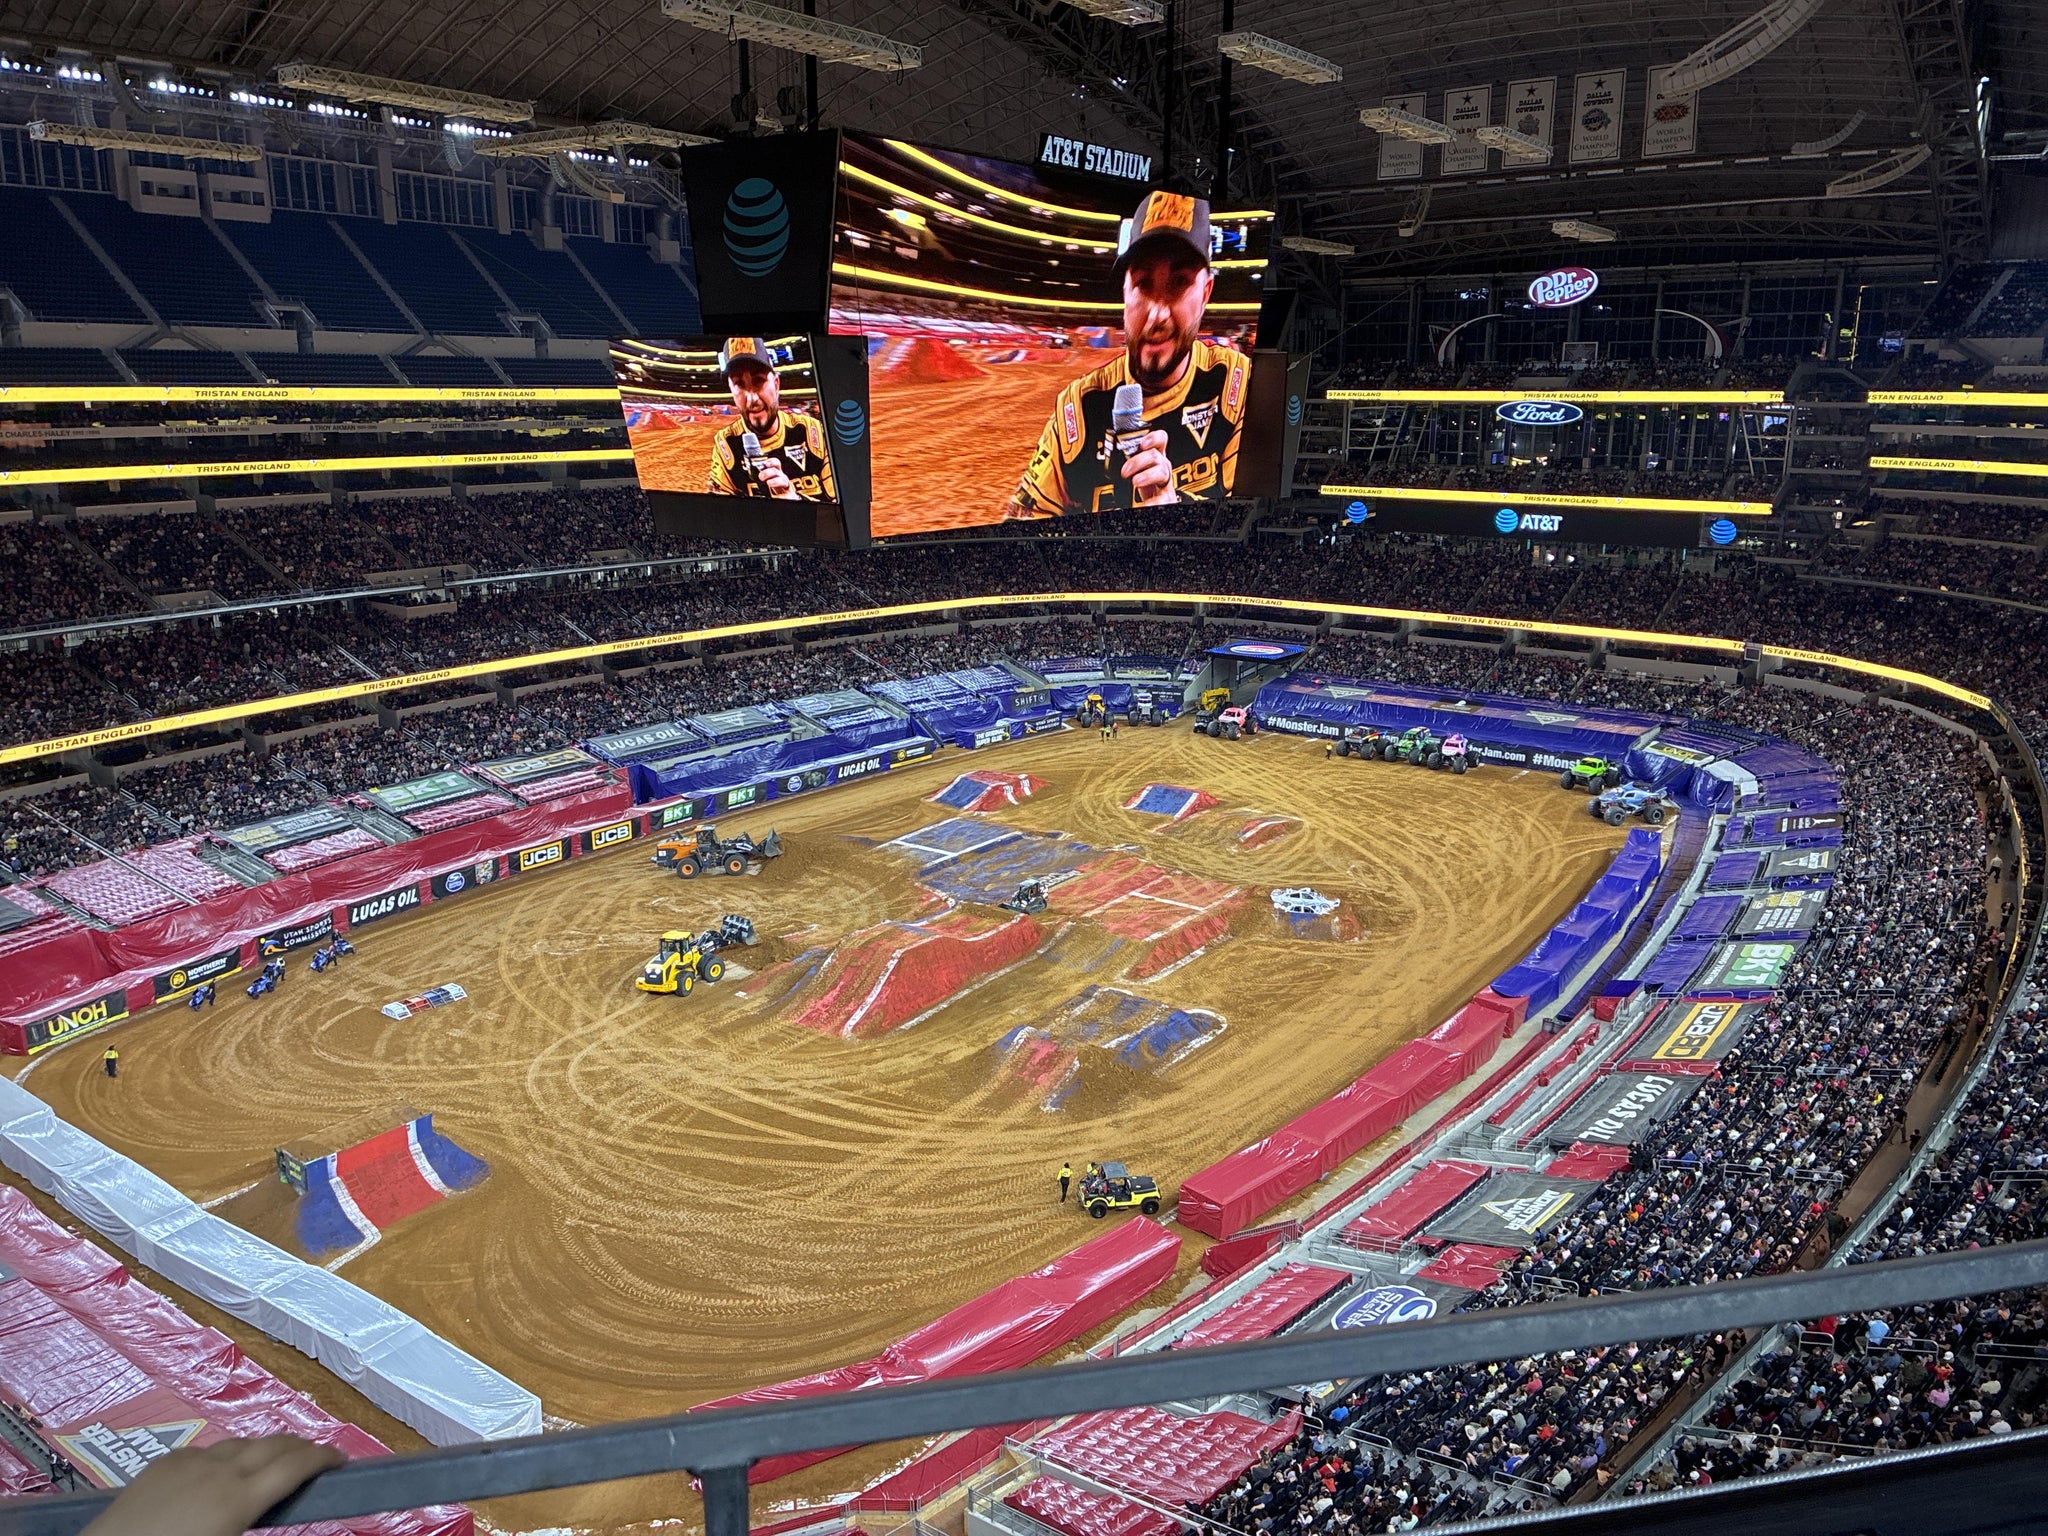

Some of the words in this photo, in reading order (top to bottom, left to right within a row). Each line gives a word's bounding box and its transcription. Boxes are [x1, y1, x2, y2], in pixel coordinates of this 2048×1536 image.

[1042, 135, 1082, 168] AT&T
[1085, 144, 1152, 182] STADIUM
[1530, 276, 1592, 304] Pepper
[1552, 272, 1577, 288] Dr
[1066, 404, 1078, 440] SIMPSON
[1513, 402, 1566, 422] Ford
[1520, 514, 1563, 532] AT&T
[1244, 598, 1284, 606] ENGLAND
[818, 612, 849, 622] TRISTAN
[850, 609, 880, 619] ENGLAND
[1446, 615, 1484, 625] TRISTAN
[1488, 618, 1534, 629] ENGLAND
[612, 640, 645, 650] TRISTAN
[646, 634, 684, 646] ENGLAND
[1794, 652, 1838, 663] ENGLAND
[363, 677, 404, 692] TRISTAN
[406, 671, 451, 684] ENGLAND
[1015, 696, 1038, 707] SHIFT
[1267, 716, 1339, 736] #MonsterJam
[34, 735, 89, 754] TRISTAN
[92, 724, 152, 741] ENGLAND
[605, 734, 653, 752] LUCAS
[653, 728, 680, 742] OIL
[1468, 745, 1526, 762] terJam.com
[838, 760, 866, 778] LUCAS
[867, 758, 880, 770] OIL
[380, 774, 460, 802] BKT
[730, 788, 755, 804] BKT
[664, 804, 693, 822] BKT
[595, 825, 629, 845] JCB
[524, 846, 559, 866] JCB
[352, 895, 394, 923] LUCAS
[397, 887, 418, 909] OIL
[284, 930, 303, 940] UTAH
[306, 917, 332, 934] SPORTS
[284, 926, 332, 947] COMMISSION
[188, 957, 228, 976] NORTHERN
[1734, 944, 1785, 984] BKT
[48, 1000, 108, 1036] UNOH
[1685, 1006, 1730, 1036] JCB
[1608, 1075, 1674, 1118] LUCAS
[1578, 1118, 1624, 1140] OIL
[1503, 1199, 1532, 1219] JAM
[1504, 1190, 1560, 1230] MONSTER
[1342, 1291, 1390, 1328] MASTER
[1352, 1292, 1404, 1327] SPIN
[79, 1422, 149, 1478] NSTER
[121, 1428, 171, 1459] JAM
